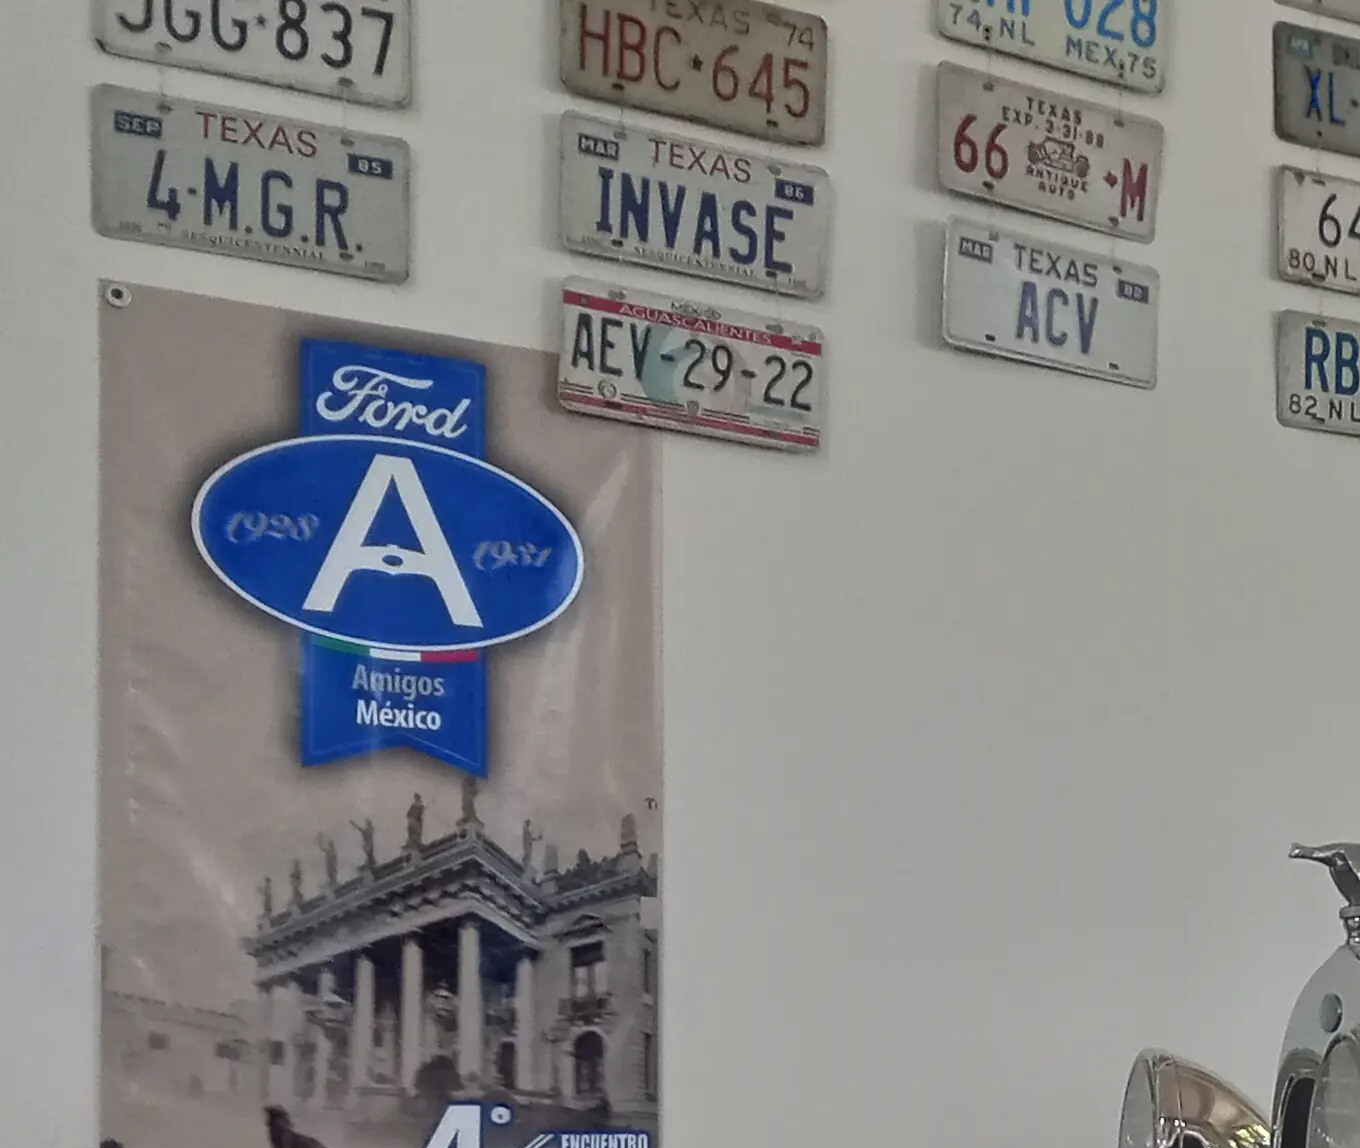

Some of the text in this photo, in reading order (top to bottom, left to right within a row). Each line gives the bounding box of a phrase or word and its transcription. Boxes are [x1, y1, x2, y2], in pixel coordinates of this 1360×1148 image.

[951, 5, 982, 31] 74
[578, 1, 810, 118] HBC 645
[1026, 96, 1082, 126] TEXAS
[195, 111, 318, 158] TEXAS
[953, 113, 1009, 180] 66
[649, 138, 751, 183] TEXAS
[1025, 164, 1089, 193] ANTIQUE
[596, 166, 794, 274] INVASE
[1014, 242, 1099, 288] TEXAS
[619, 304, 773, 345] AGUASCALIENTES
[1015, 280, 1099, 354] ACV
[571, 313, 814, 412] AEV-29-22
[316, 364, 472, 438] Ford
[302, 453, 484, 628] A
[352, 664, 445, 700] Amigos
[356, 698, 441, 731] México
